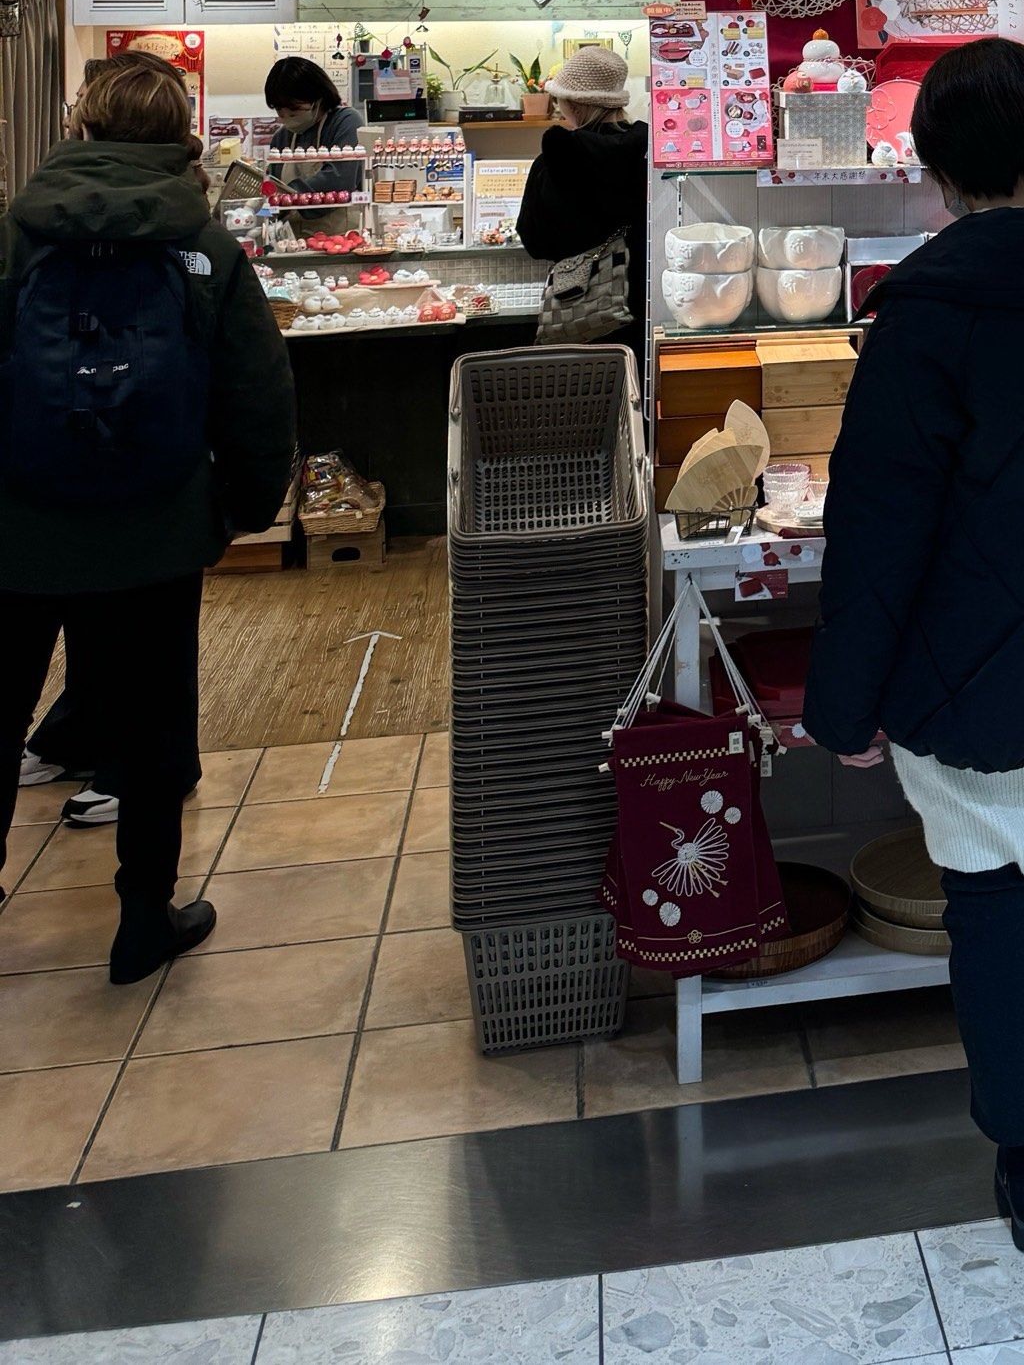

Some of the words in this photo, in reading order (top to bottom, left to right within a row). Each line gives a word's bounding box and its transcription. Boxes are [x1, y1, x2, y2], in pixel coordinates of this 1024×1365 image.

[813, 170, 867, 182] 年末大感謝祭
[178, 250, 197, 259] THE
[640, 773, 676, 792] Happy
[679, 768, 701, 784] New
[699, 768, 729, 787] Year
